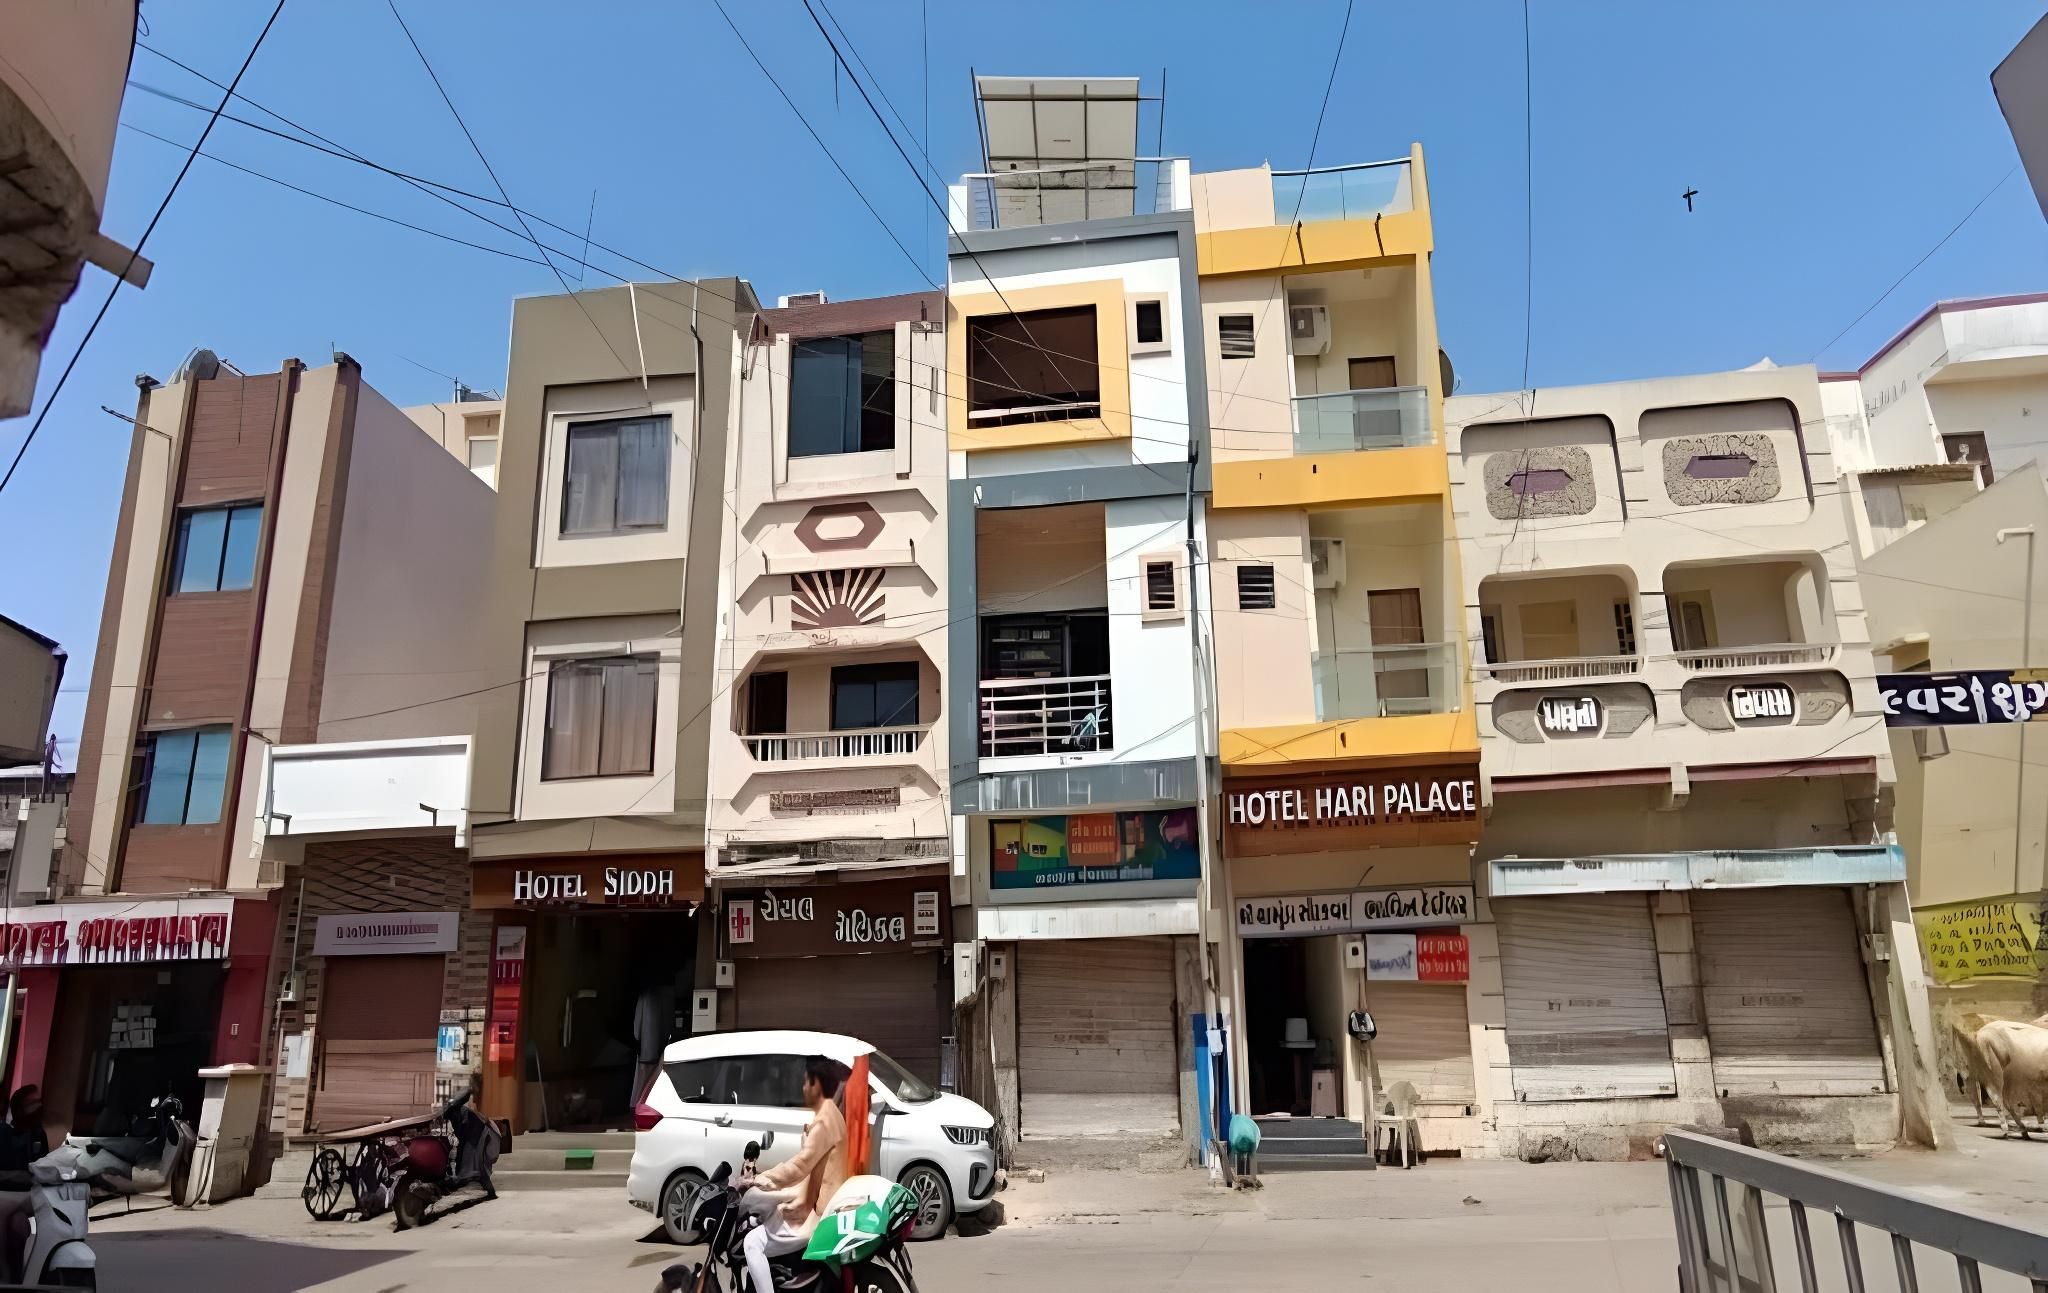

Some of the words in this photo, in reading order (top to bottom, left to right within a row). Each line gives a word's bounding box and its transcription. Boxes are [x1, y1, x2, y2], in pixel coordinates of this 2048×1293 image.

[1229, 789, 1309, 824] HOTEL
[1315, 785, 1375, 819] HARI
[1384, 780, 1477, 815] PALACE
[513, 870, 588, 900] HOTEL
[604, 867, 674, 896] SIDDH
